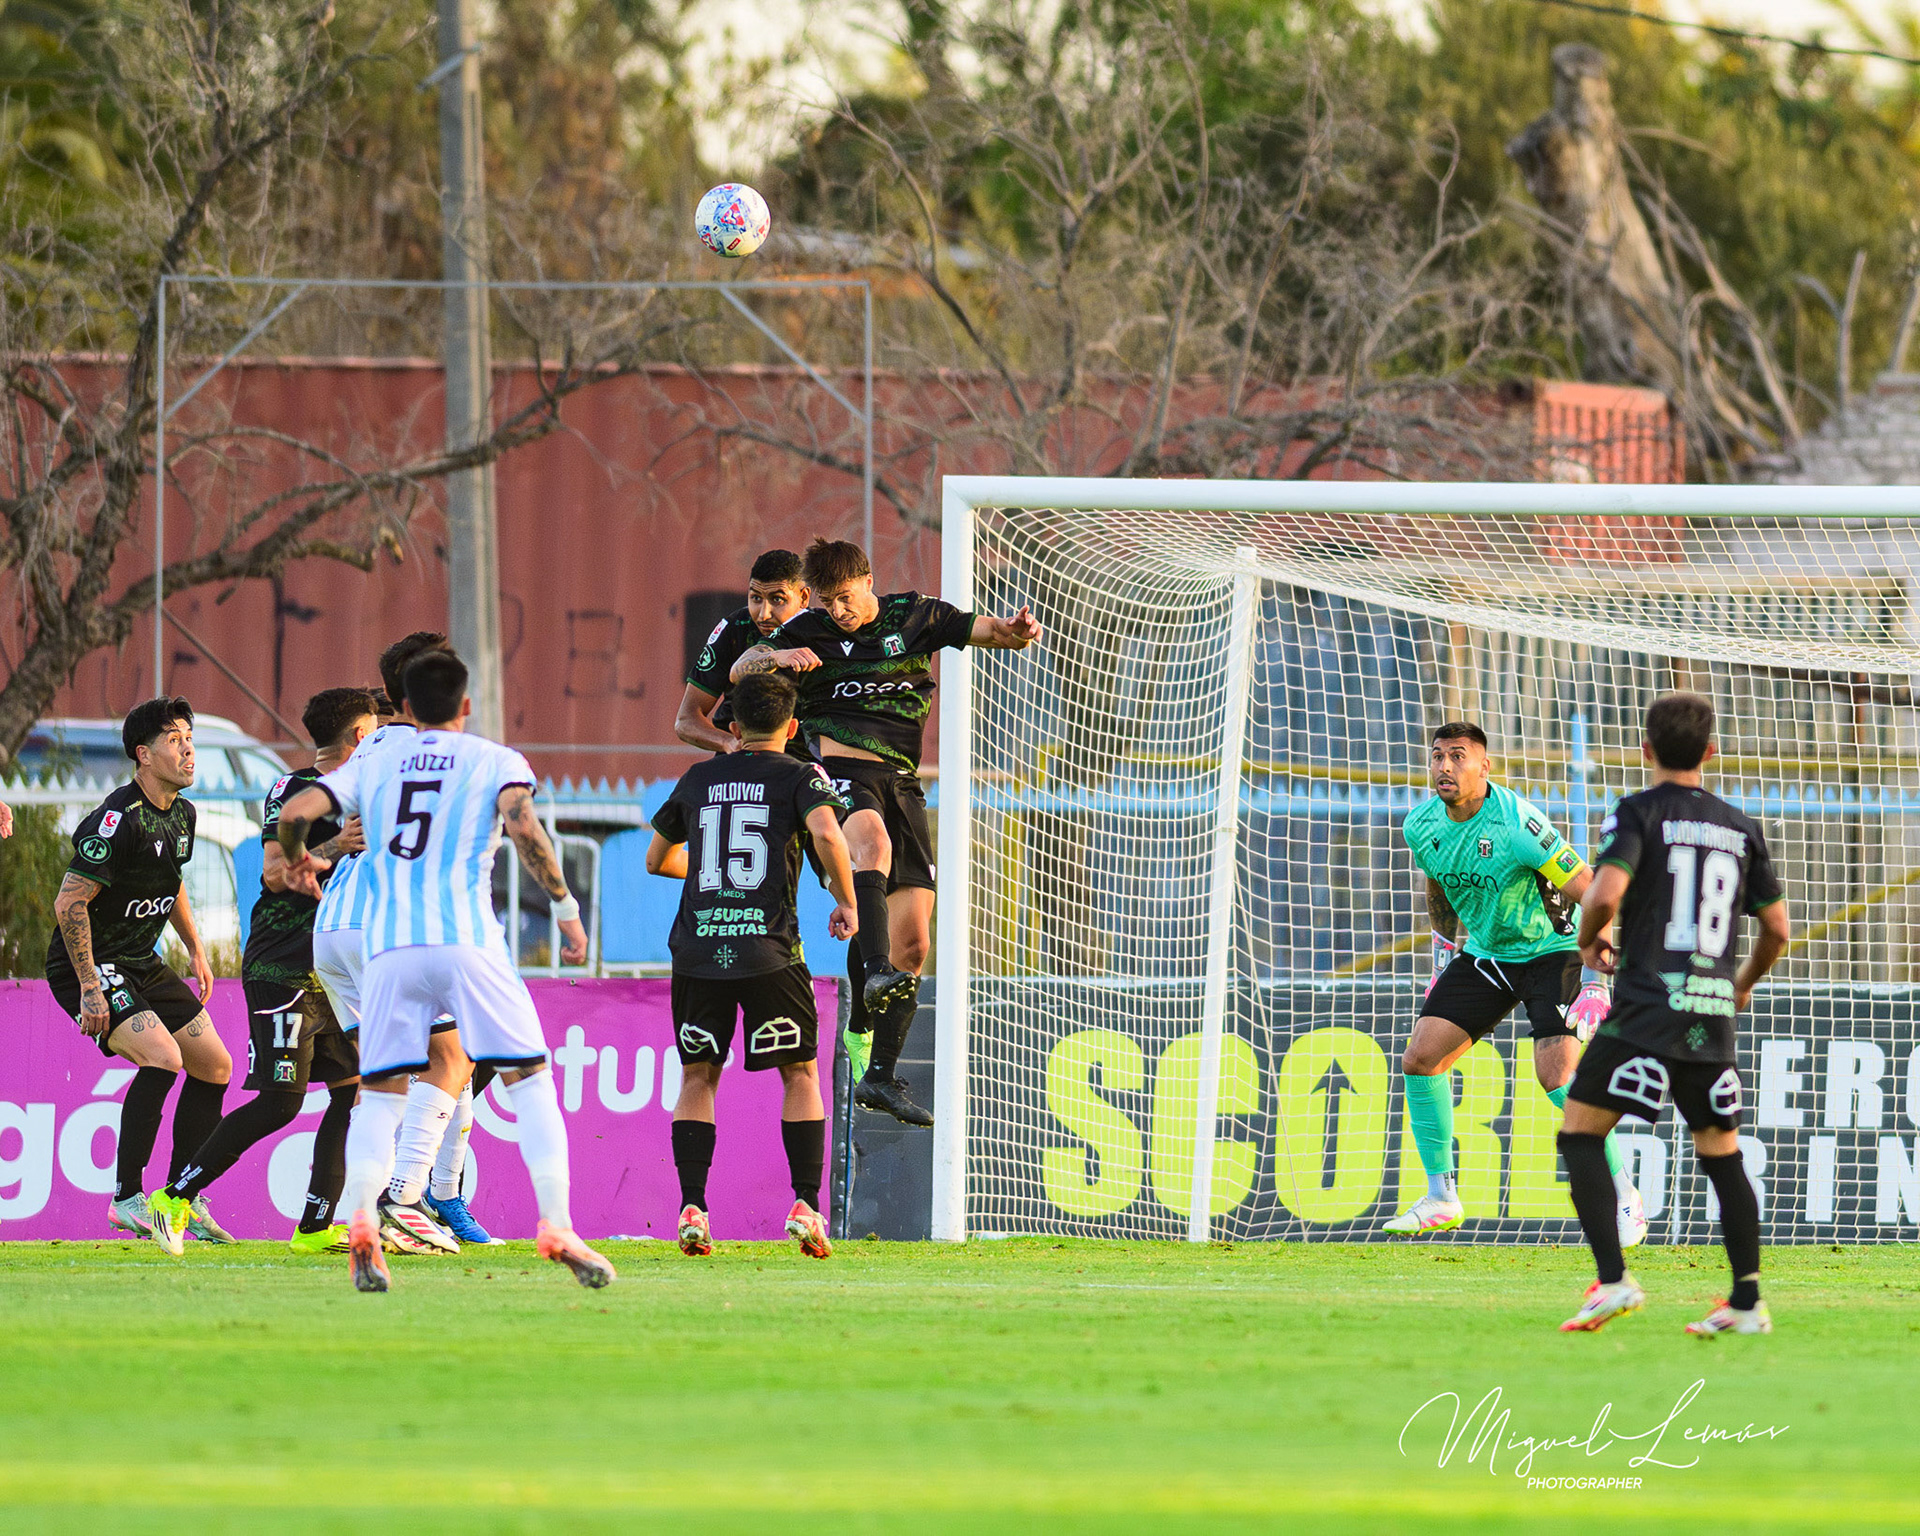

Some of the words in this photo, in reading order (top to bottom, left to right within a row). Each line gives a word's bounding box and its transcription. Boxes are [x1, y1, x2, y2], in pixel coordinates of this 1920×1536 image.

[832, 681, 913, 698] rosen
[708, 783, 765, 803] VALDIVIA
[388, 779, 443, 861] 5
[699, 804, 770, 892] 15
[1437, 871, 1500, 893] rosen
[723, 890, 746, 899] MEDS
[1663, 845, 1740, 958] 18
[125, 896, 179, 918] rose
[712, 907, 765, 923] SUPER
[696, 923, 768, 937] OFERTAS
[272, 1012, 303, 1049] 17
